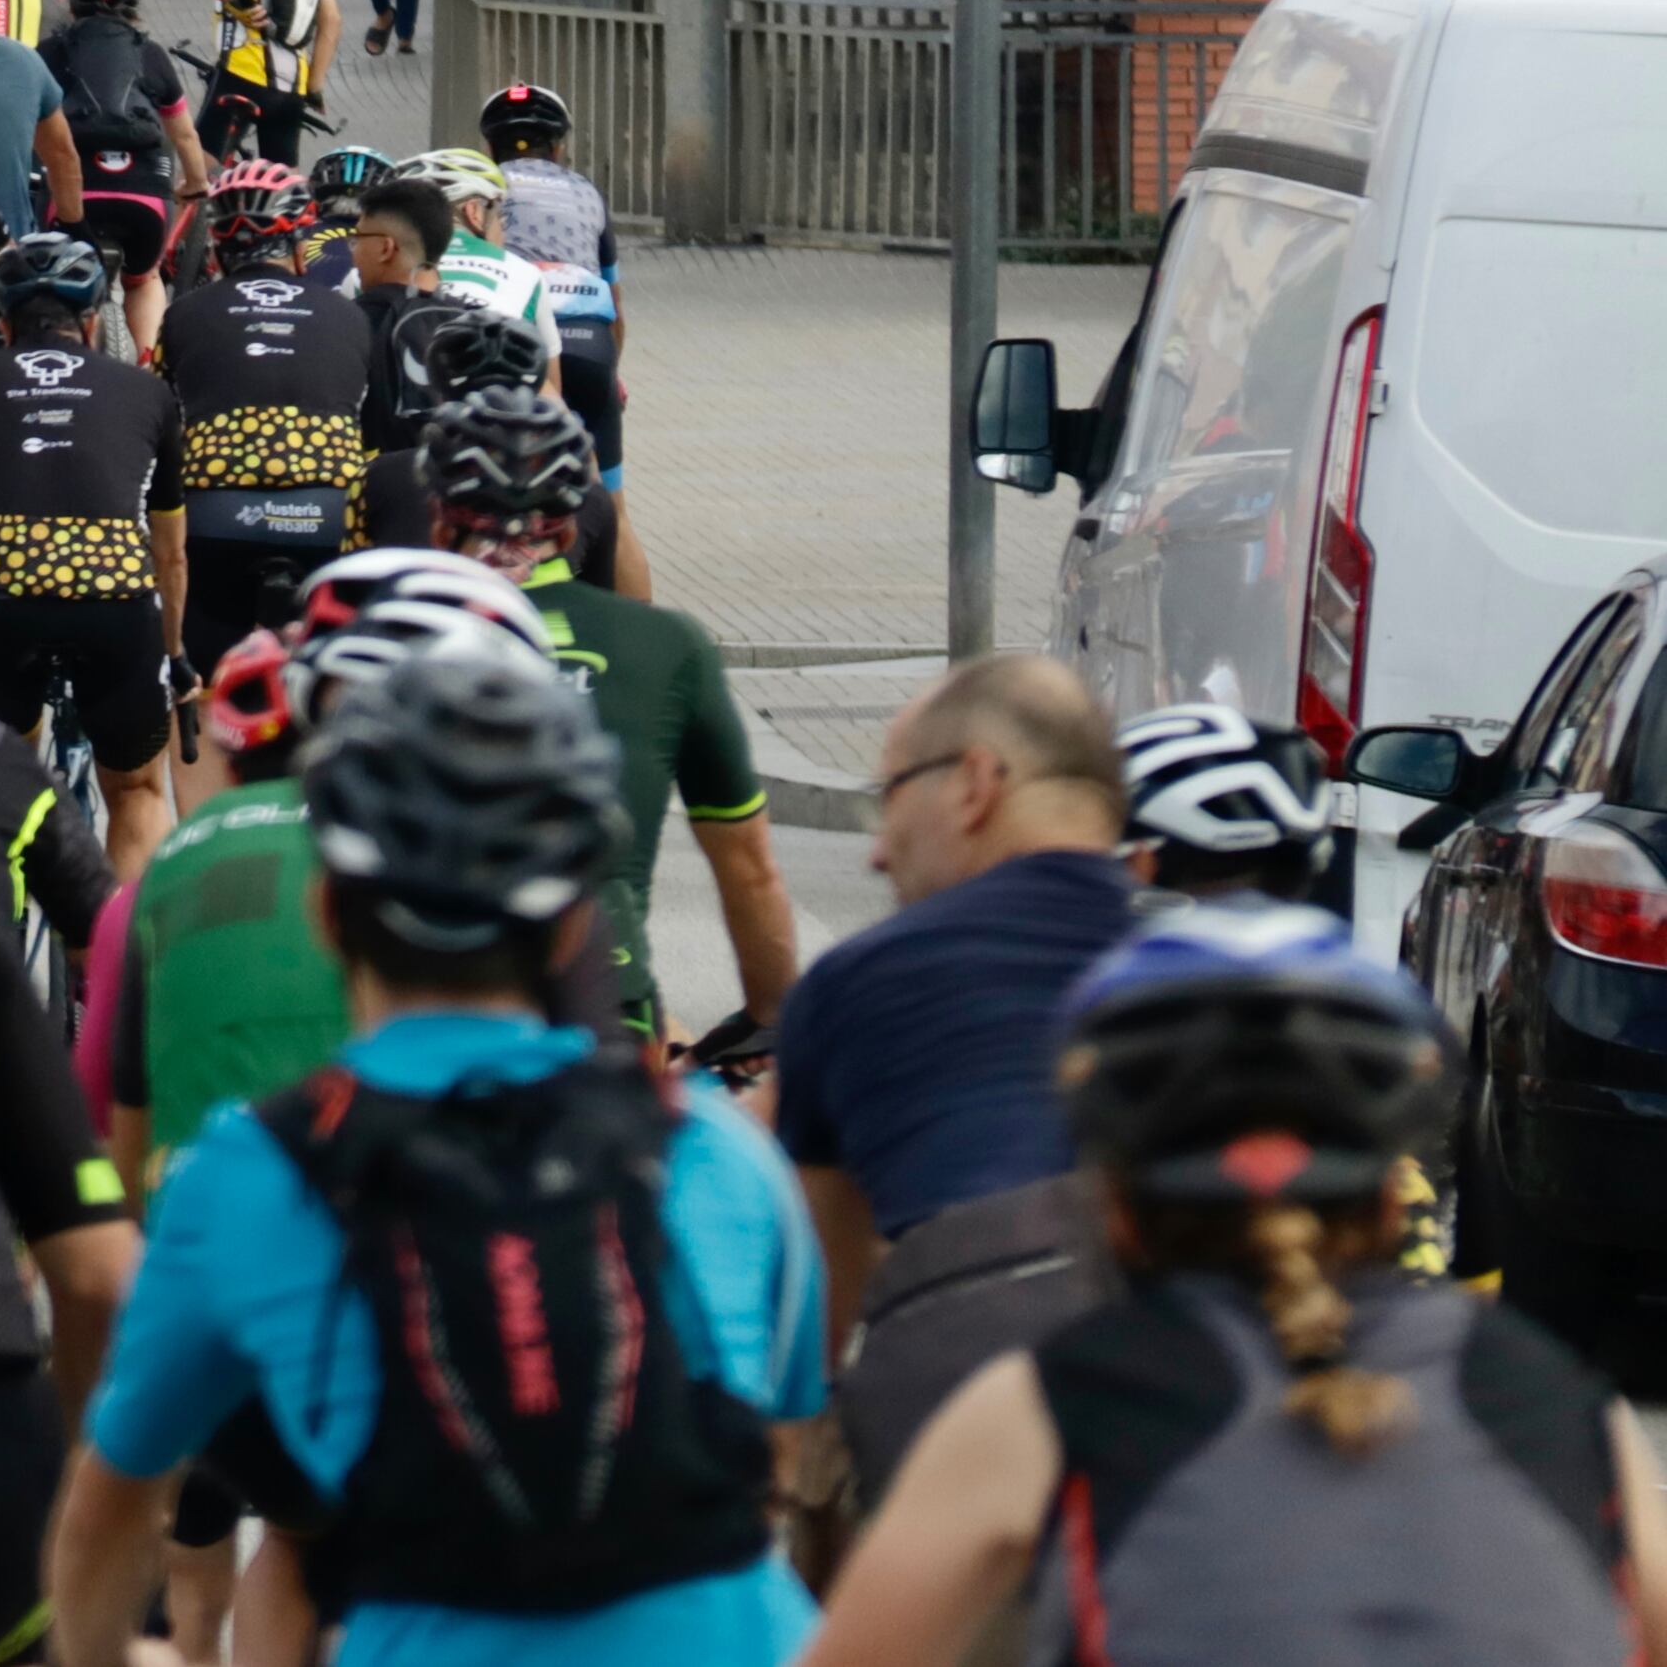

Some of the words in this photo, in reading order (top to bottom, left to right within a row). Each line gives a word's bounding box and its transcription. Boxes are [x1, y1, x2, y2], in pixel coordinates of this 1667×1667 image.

[548, 283, 600, 297] RUBI
[6, 387, 28, 399] The
[264, 499, 322, 518] fusteria
[268, 519, 319, 533] rebato
[1428, 713, 1515, 732] TRAN
